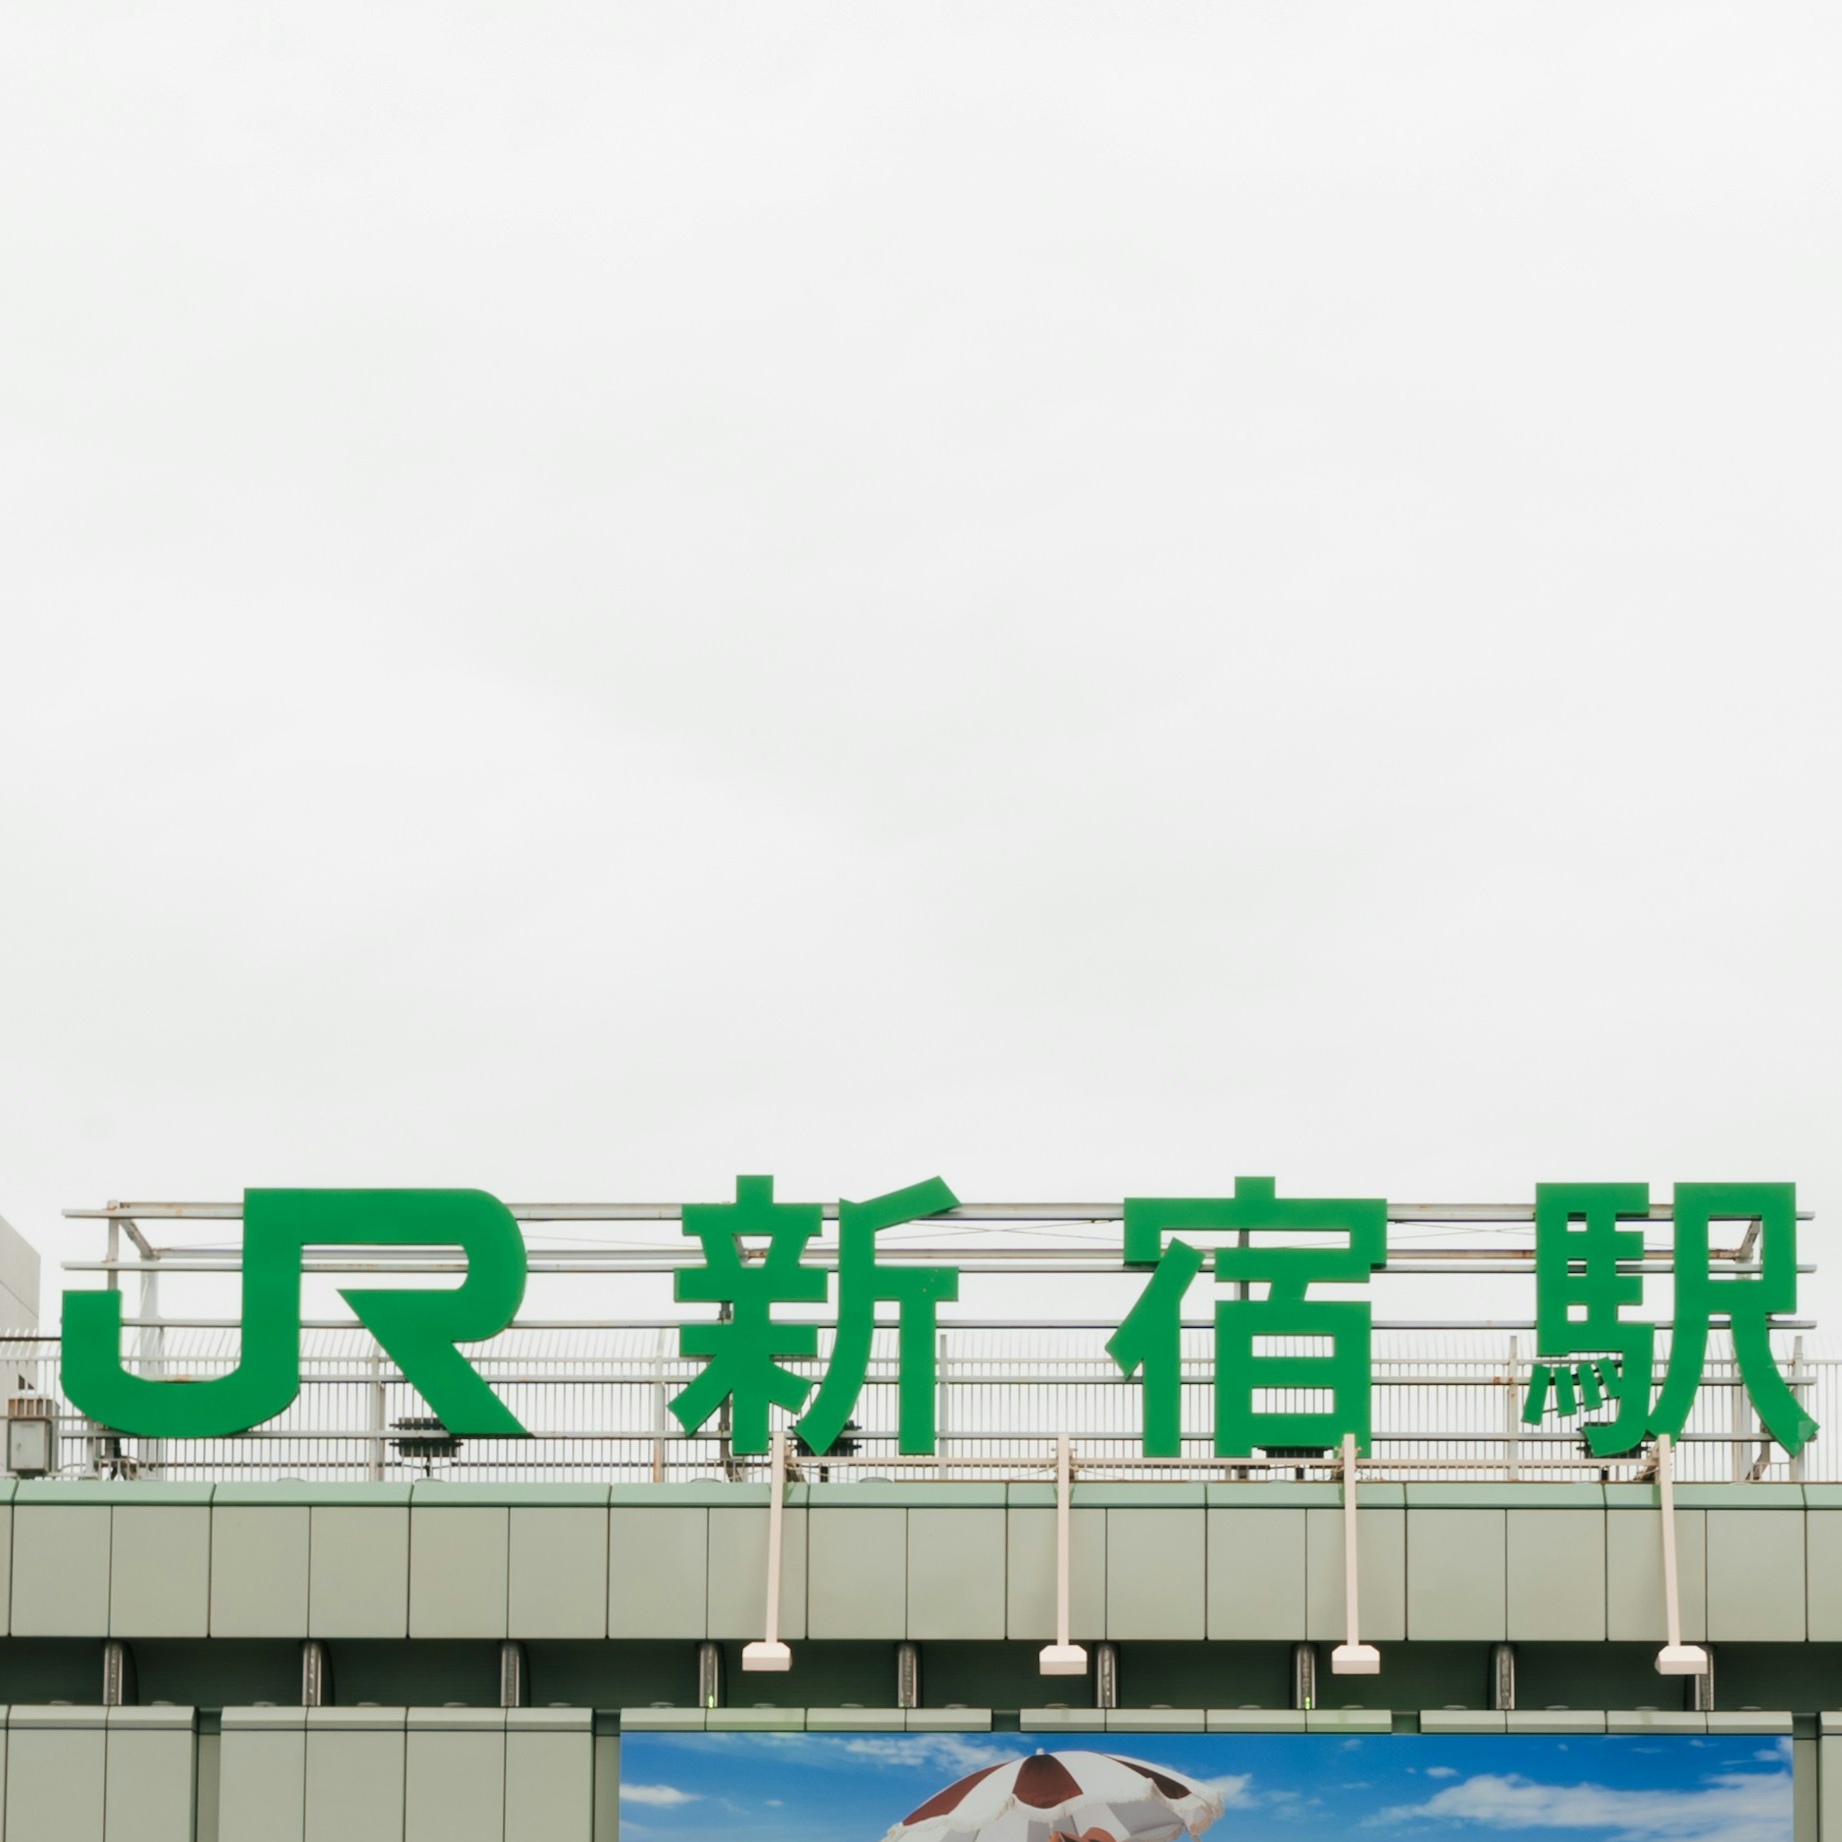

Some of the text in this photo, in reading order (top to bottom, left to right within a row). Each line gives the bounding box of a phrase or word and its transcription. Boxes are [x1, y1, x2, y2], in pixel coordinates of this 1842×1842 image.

[60, 1175, 1819, 1460] JR 新宿駅
